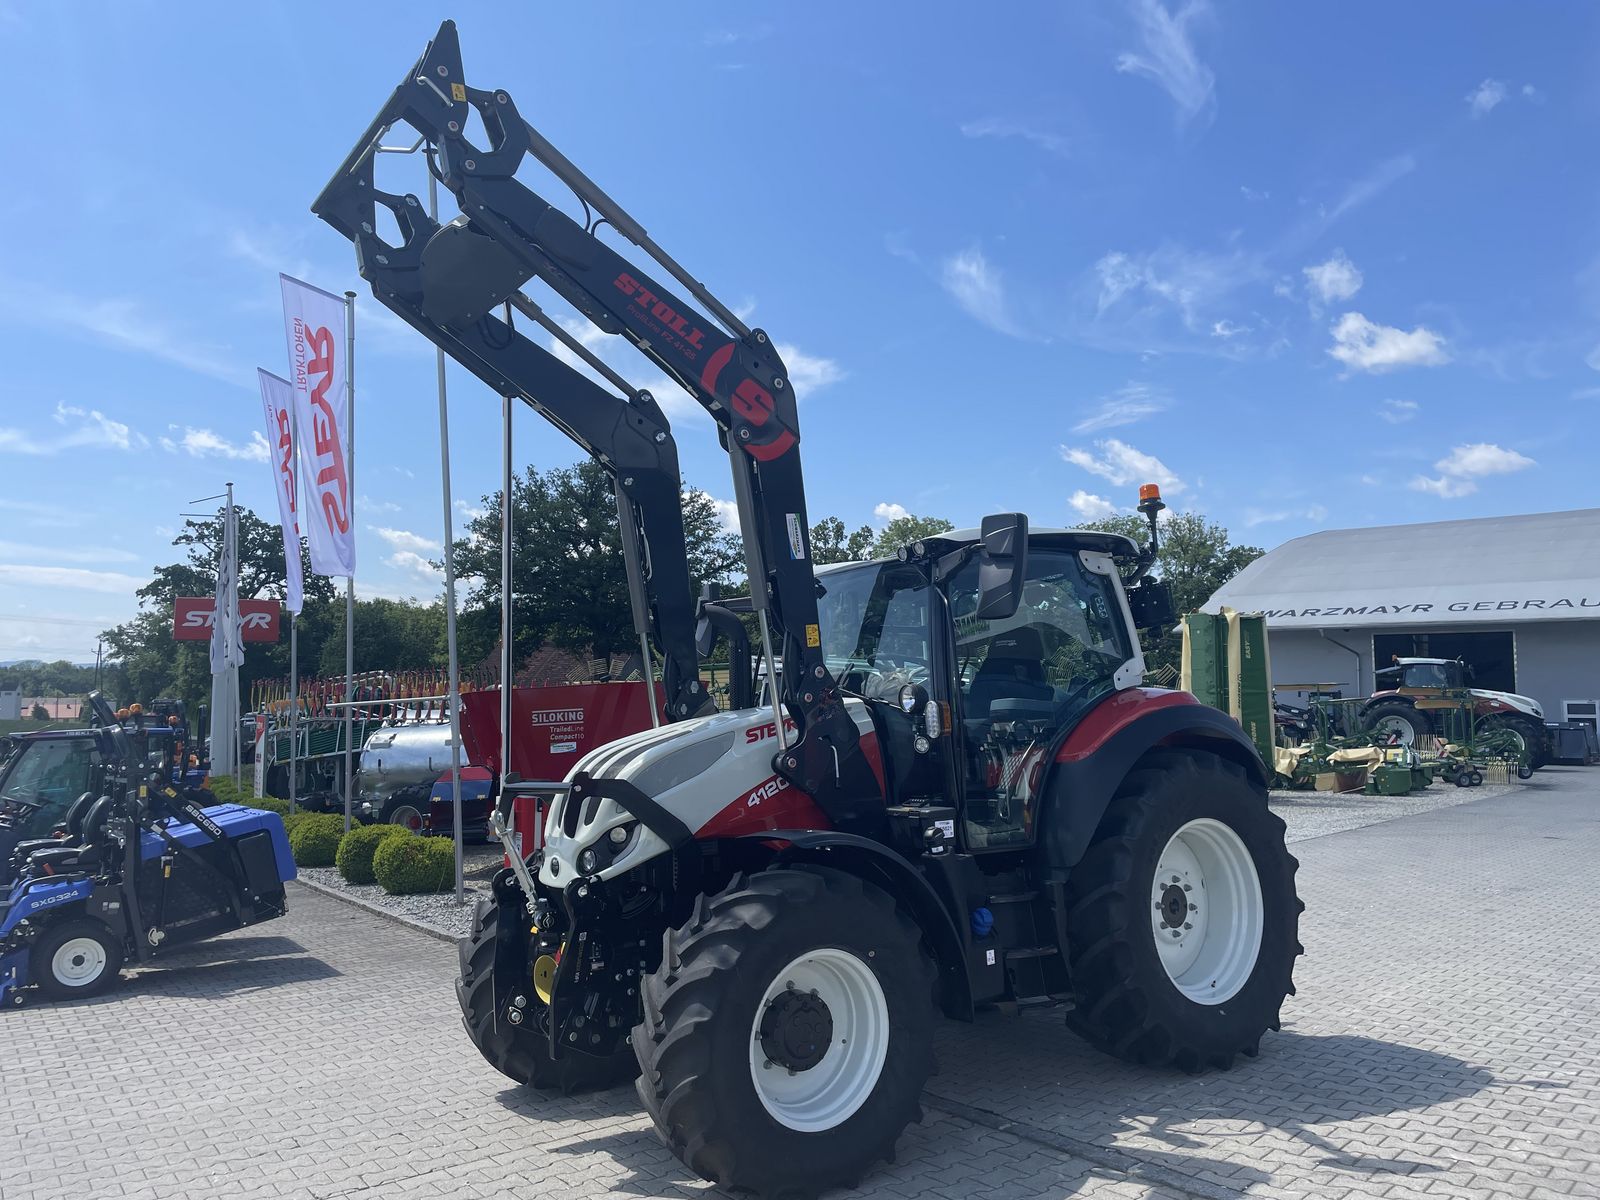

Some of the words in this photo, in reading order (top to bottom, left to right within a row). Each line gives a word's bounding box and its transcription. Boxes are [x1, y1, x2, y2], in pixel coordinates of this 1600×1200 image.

[613, 272, 705, 350] STOLL
[1239, 604, 1433, 618] WARZMAYR
[532, 711, 584, 723] SILOKING
[745, 718, 800, 744] STER
[747, 777, 790, 807] 4120
[31, 890, 79, 909] SXG324
